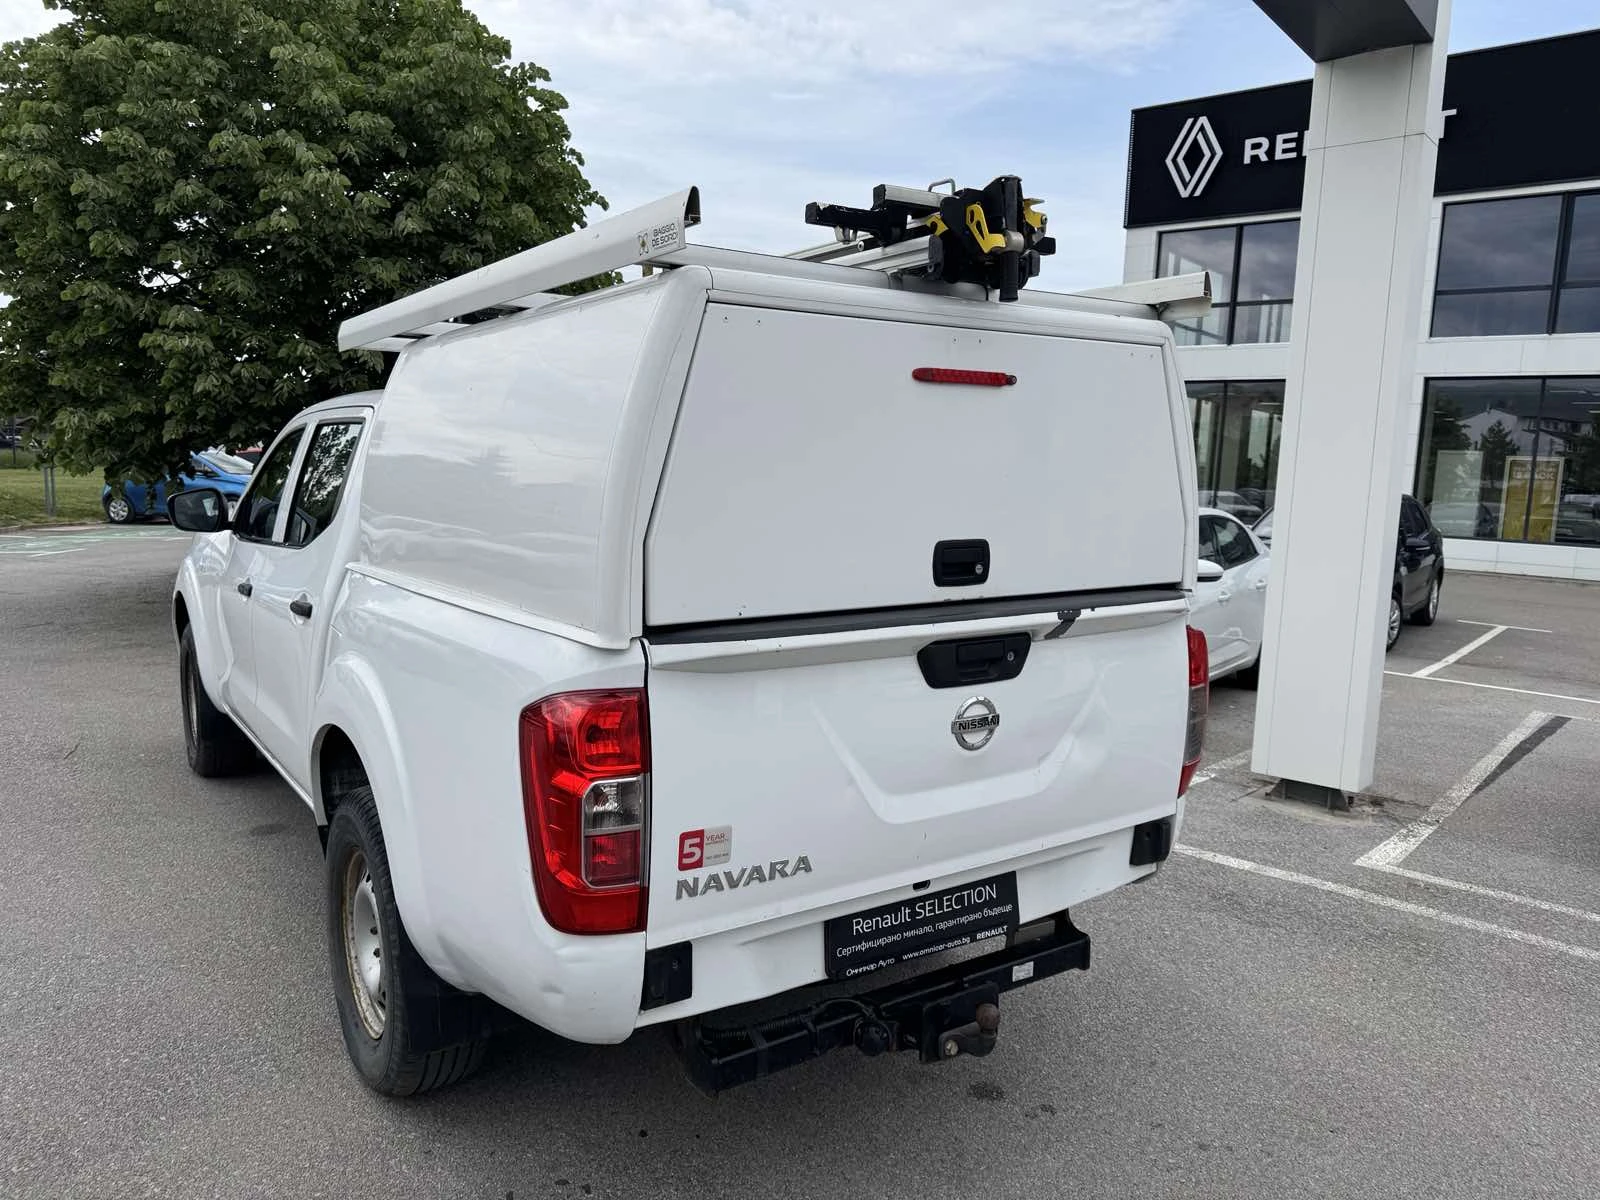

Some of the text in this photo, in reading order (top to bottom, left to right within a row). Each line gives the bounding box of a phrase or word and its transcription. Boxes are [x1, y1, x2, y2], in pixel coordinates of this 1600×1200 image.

[958, 714, 997, 731] NISSAN
[682, 837, 702, 864] 5
[676, 855, 813, 901] NAVARA
[852, 883, 997, 936] Renault SELECTION
[836, 903, 1013, 958] Сертифицирано минало, гарантирано бъдеще
[976, 925, 1007, 940] RENAULT
[877, 957, 896, 968] Ауто
